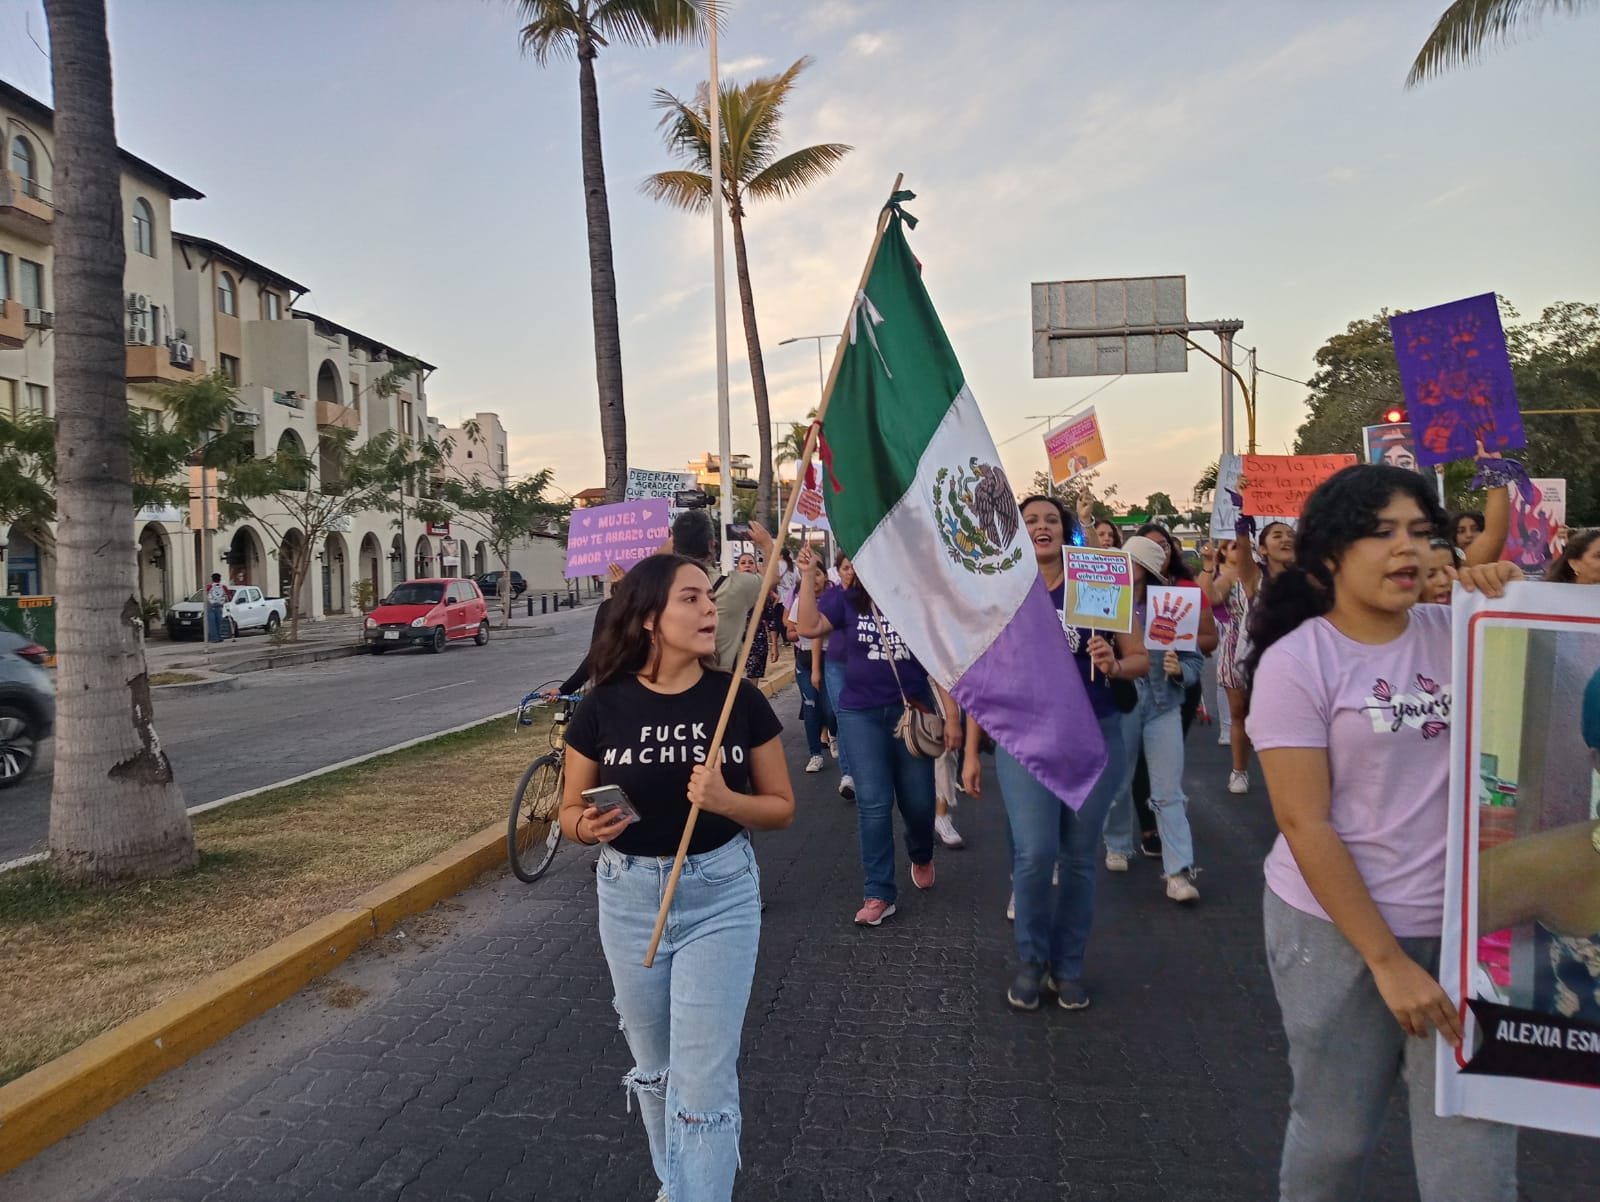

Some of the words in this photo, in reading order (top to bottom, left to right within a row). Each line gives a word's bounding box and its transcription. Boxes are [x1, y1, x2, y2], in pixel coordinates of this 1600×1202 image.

[1247, 456, 1278, 473] Soy
[1287, 456, 1305, 472] la
[629, 470, 680, 482] DEBERIAN
[1276, 475, 1292, 489] la
[626, 487, 646, 497] QUE
[635, 480, 687, 491] AGRADECER
[1251, 490, 1273, 501] que
[598, 511, 637, 528] MUJER
[591, 533, 603, 545] TE
[605, 528, 644, 543] ABRAZO
[646, 526, 669, 540] CON
[567, 551, 602, 567] AMOR
[604, 549, 613, 561] Y
[1112, 564, 1125, 573] NO
[858, 633, 874, 643] no
[640, 722, 707, 743] FUCK
[1495, 1019, 1562, 1049] ALEXIA
[1566, 1028, 1600, 1054] ESM
